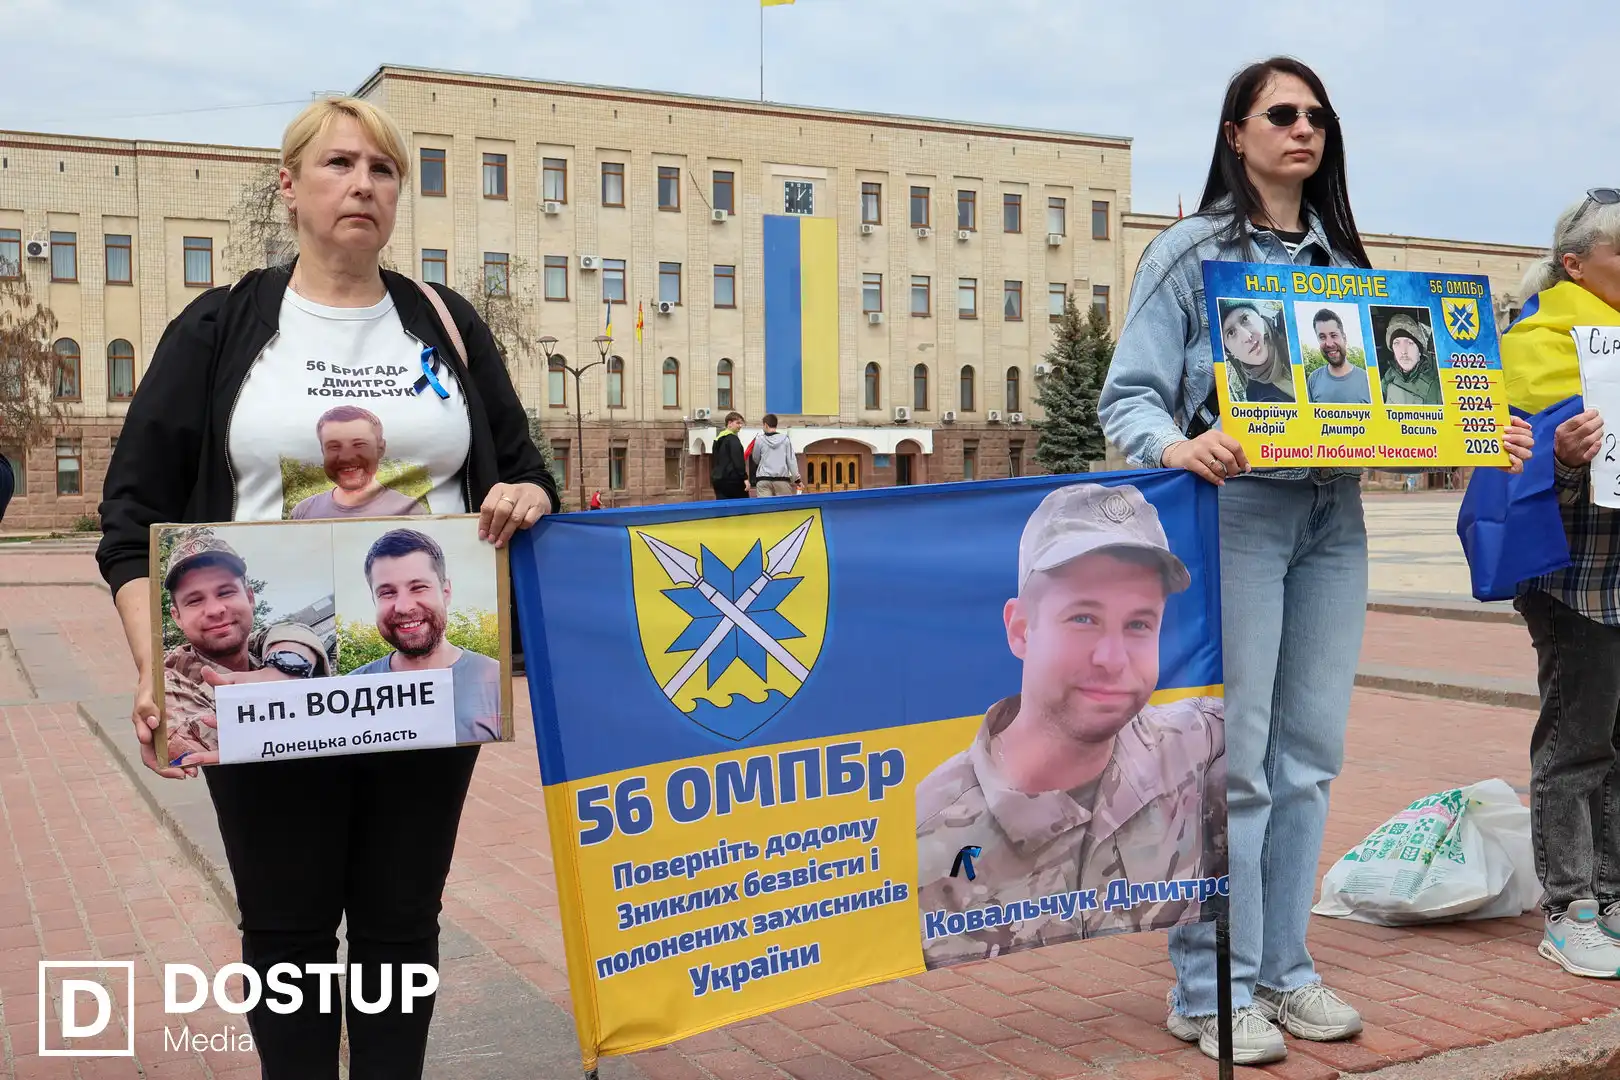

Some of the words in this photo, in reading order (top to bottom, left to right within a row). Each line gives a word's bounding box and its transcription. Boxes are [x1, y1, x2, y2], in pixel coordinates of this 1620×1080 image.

[1245, 274, 1287, 293] н.п.
[1291, 271, 1389, 299] ВОДЯНЕ
[1429, 280, 1443, 294] 56
[1446, 280, 1484, 298] ОМПБр
[306, 360, 326, 372] 56
[331, 363, 409, 376] БРИГАДА
[1451, 353, 1487, 369] 2022
[322, 377, 396, 389] ДМИТРО
[1454, 374, 1490, 390] 2023
[307, 387, 416, 398] КОВАЛЬЧУК
[1458, 396, 1493, 411] 2024
[1231, 406, 1298, 420] Онофрійчук
[1313, 407, 1371, 421] Ковальчук
[1386, 409, 1444, 422] Тартачний
[1248, 421, 1286, 436] Андрій
[1321, 423, 1366, 437] Дмитро
[1401, 424, 1437, 435] Василь
[1461, 417, 1497, 433] 2025
[1260, 443, 1313, 462] Віримо!
[1316, 444, 1375, 459] Любимо!
[1378, 445, 1438, 458] Чекаємо!
[1465, 438, 1500, 454] 2026
[236, 700, 296, 724] н.п.
[306, 681, 436, 719] ВОДЯНЕ
[260, 734, 348, 758] Донецька
[351, 727, 418, 747] область
[576, 776, 653, 847] 56
[666, 741, 906, 824] ОМПБр
[613, 839, 760, 891] Поверніть
[765, 817, 880, 860] додому
[616, 881, 740, 931] Зниклих
[743, 854, 866, 898] безвісти
[868, 847, 881, 872] і
[924, 887, 1099, 940] Ковальчук
[1104, 874, 1229, 912] Дмитро
[596, 917, 749, 980] полонених
[752, 879, 909, 935] захисників
[689, 942, 821, 997] України
